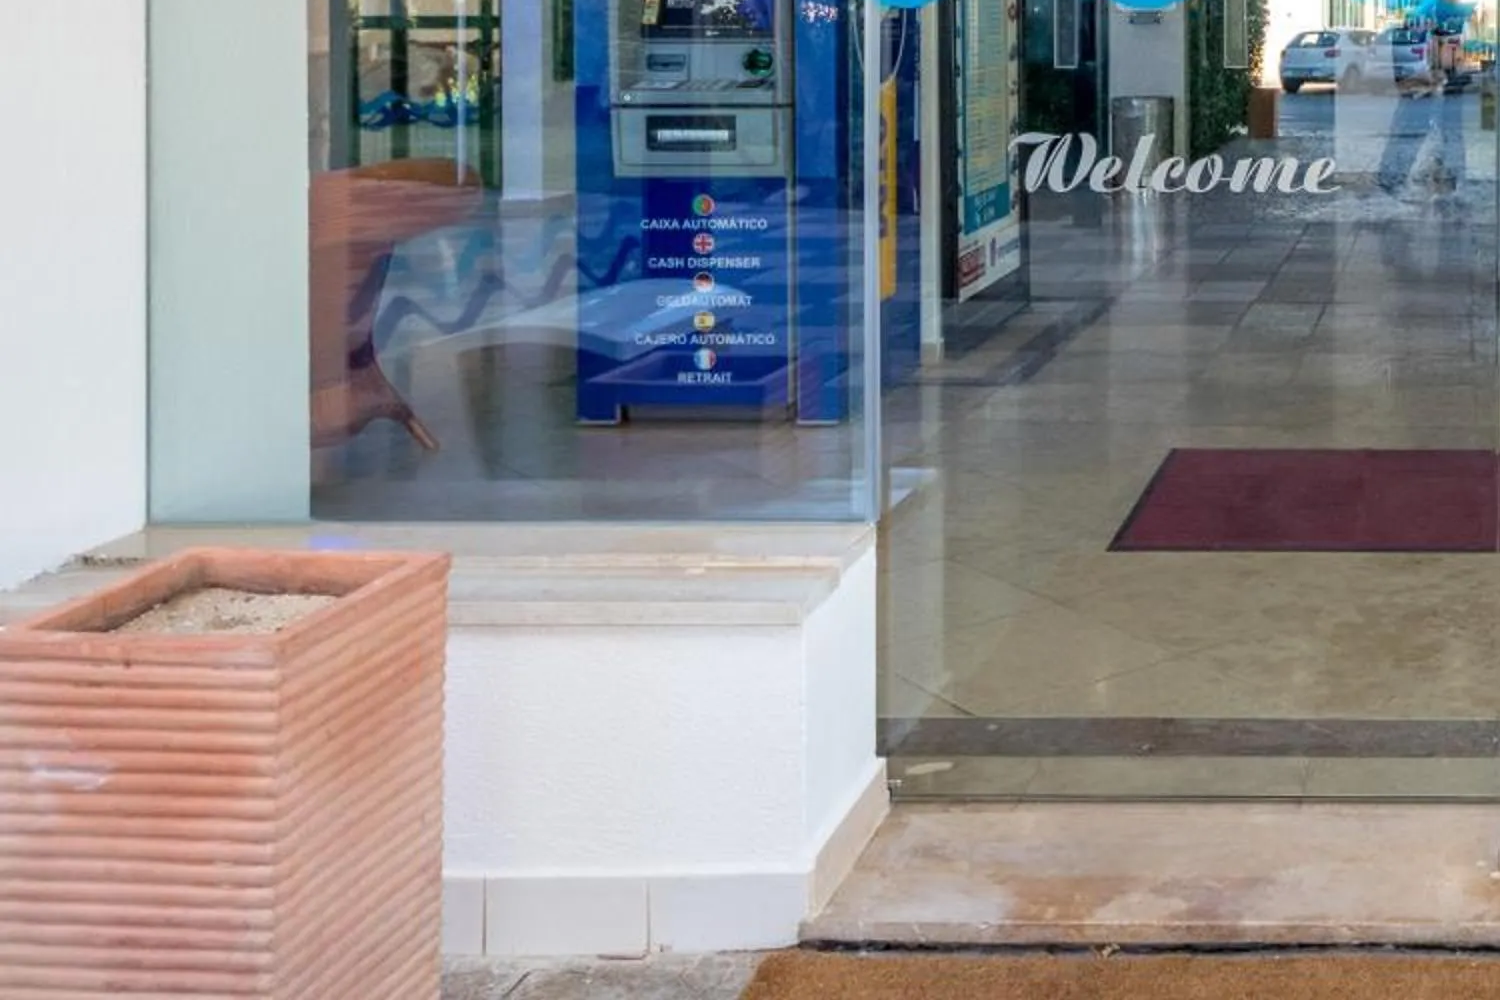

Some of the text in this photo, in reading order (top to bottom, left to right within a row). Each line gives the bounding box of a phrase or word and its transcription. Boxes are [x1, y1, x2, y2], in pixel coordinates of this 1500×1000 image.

[1007, 132, 1342, 193] Welcome
[640, 219, 680, 229] CAIXA
[648, 257, 760, 268] CASH DISPENSER
[656, 295, 753, 307] GELDAUTOMAT
[635, 333, 687, 345] CAJERO
[677, 372, 732, 384] RETRAIT
